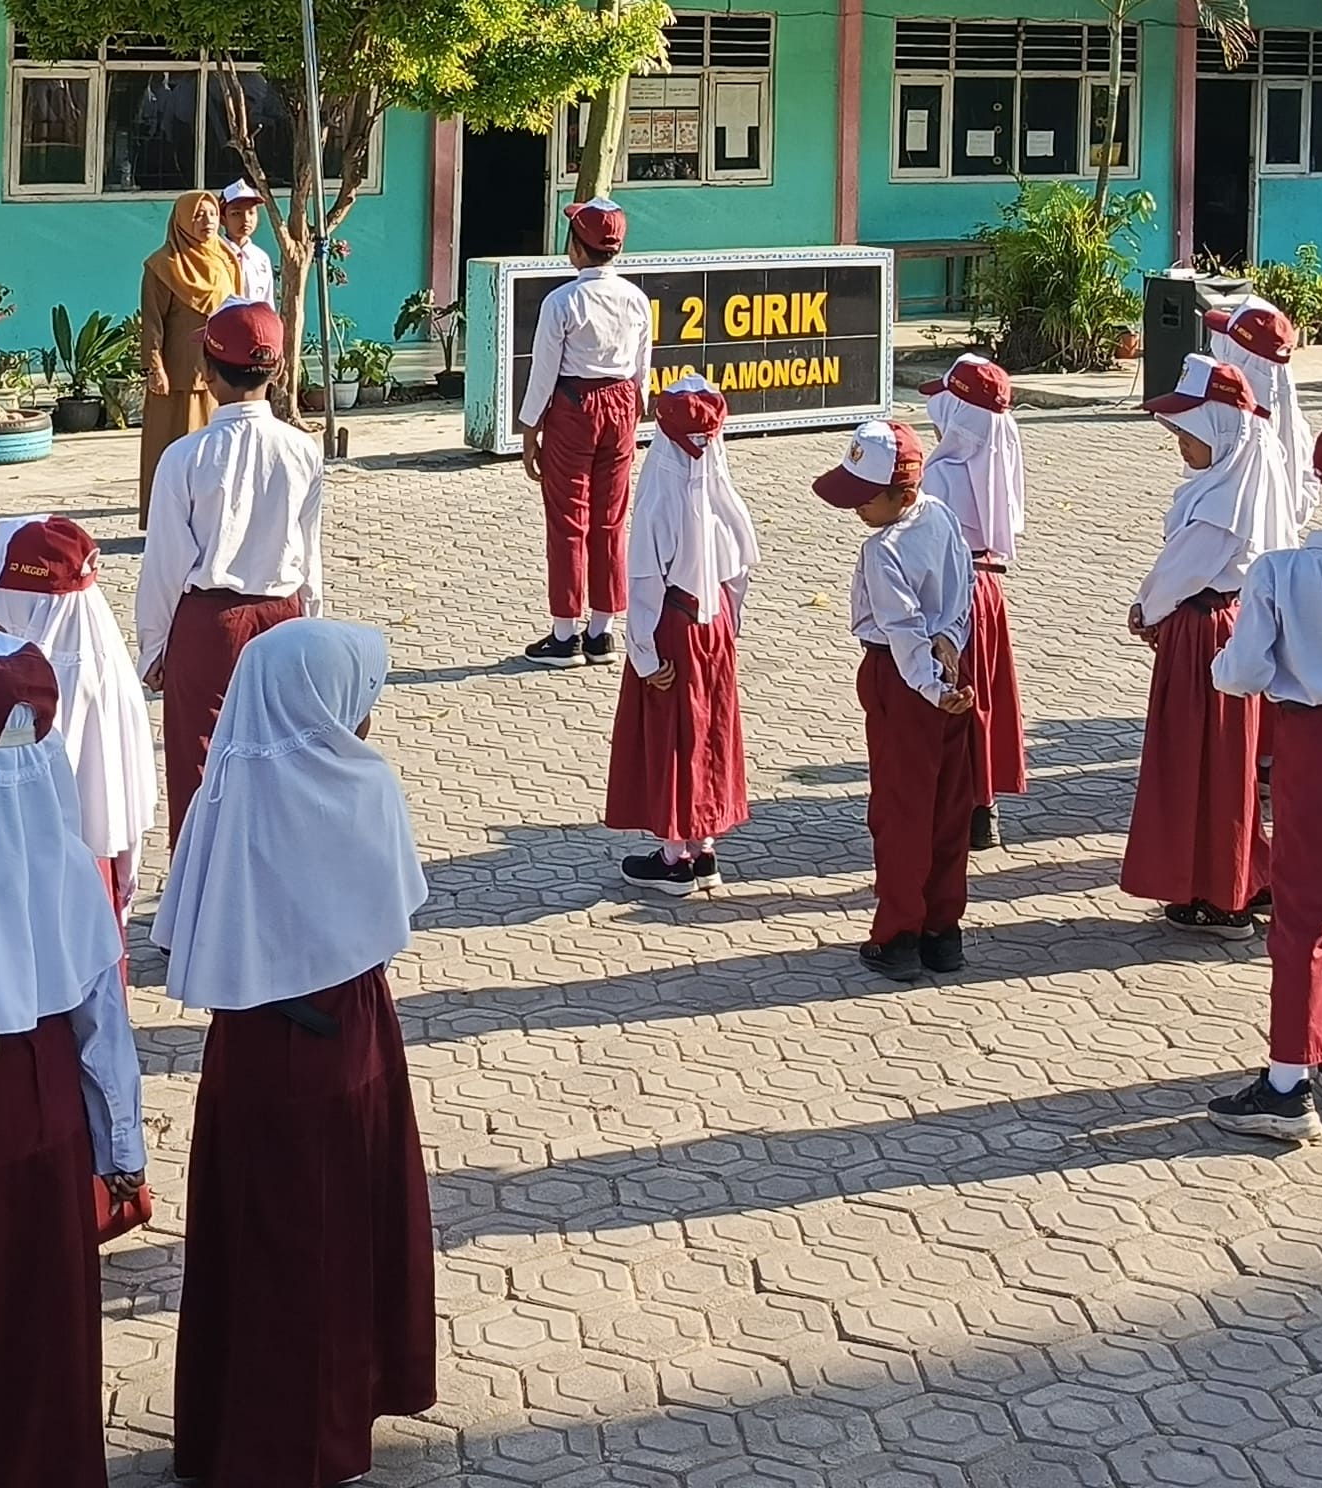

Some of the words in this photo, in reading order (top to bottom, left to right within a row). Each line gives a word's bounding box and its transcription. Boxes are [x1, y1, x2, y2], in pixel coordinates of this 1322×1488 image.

[680, 296, 704, 341] 2
[724, 291, 828, 337] GIRIK
[706, 356, 840, 393] LAMONGAN
[20, 563, 50, 577] NEGERI
